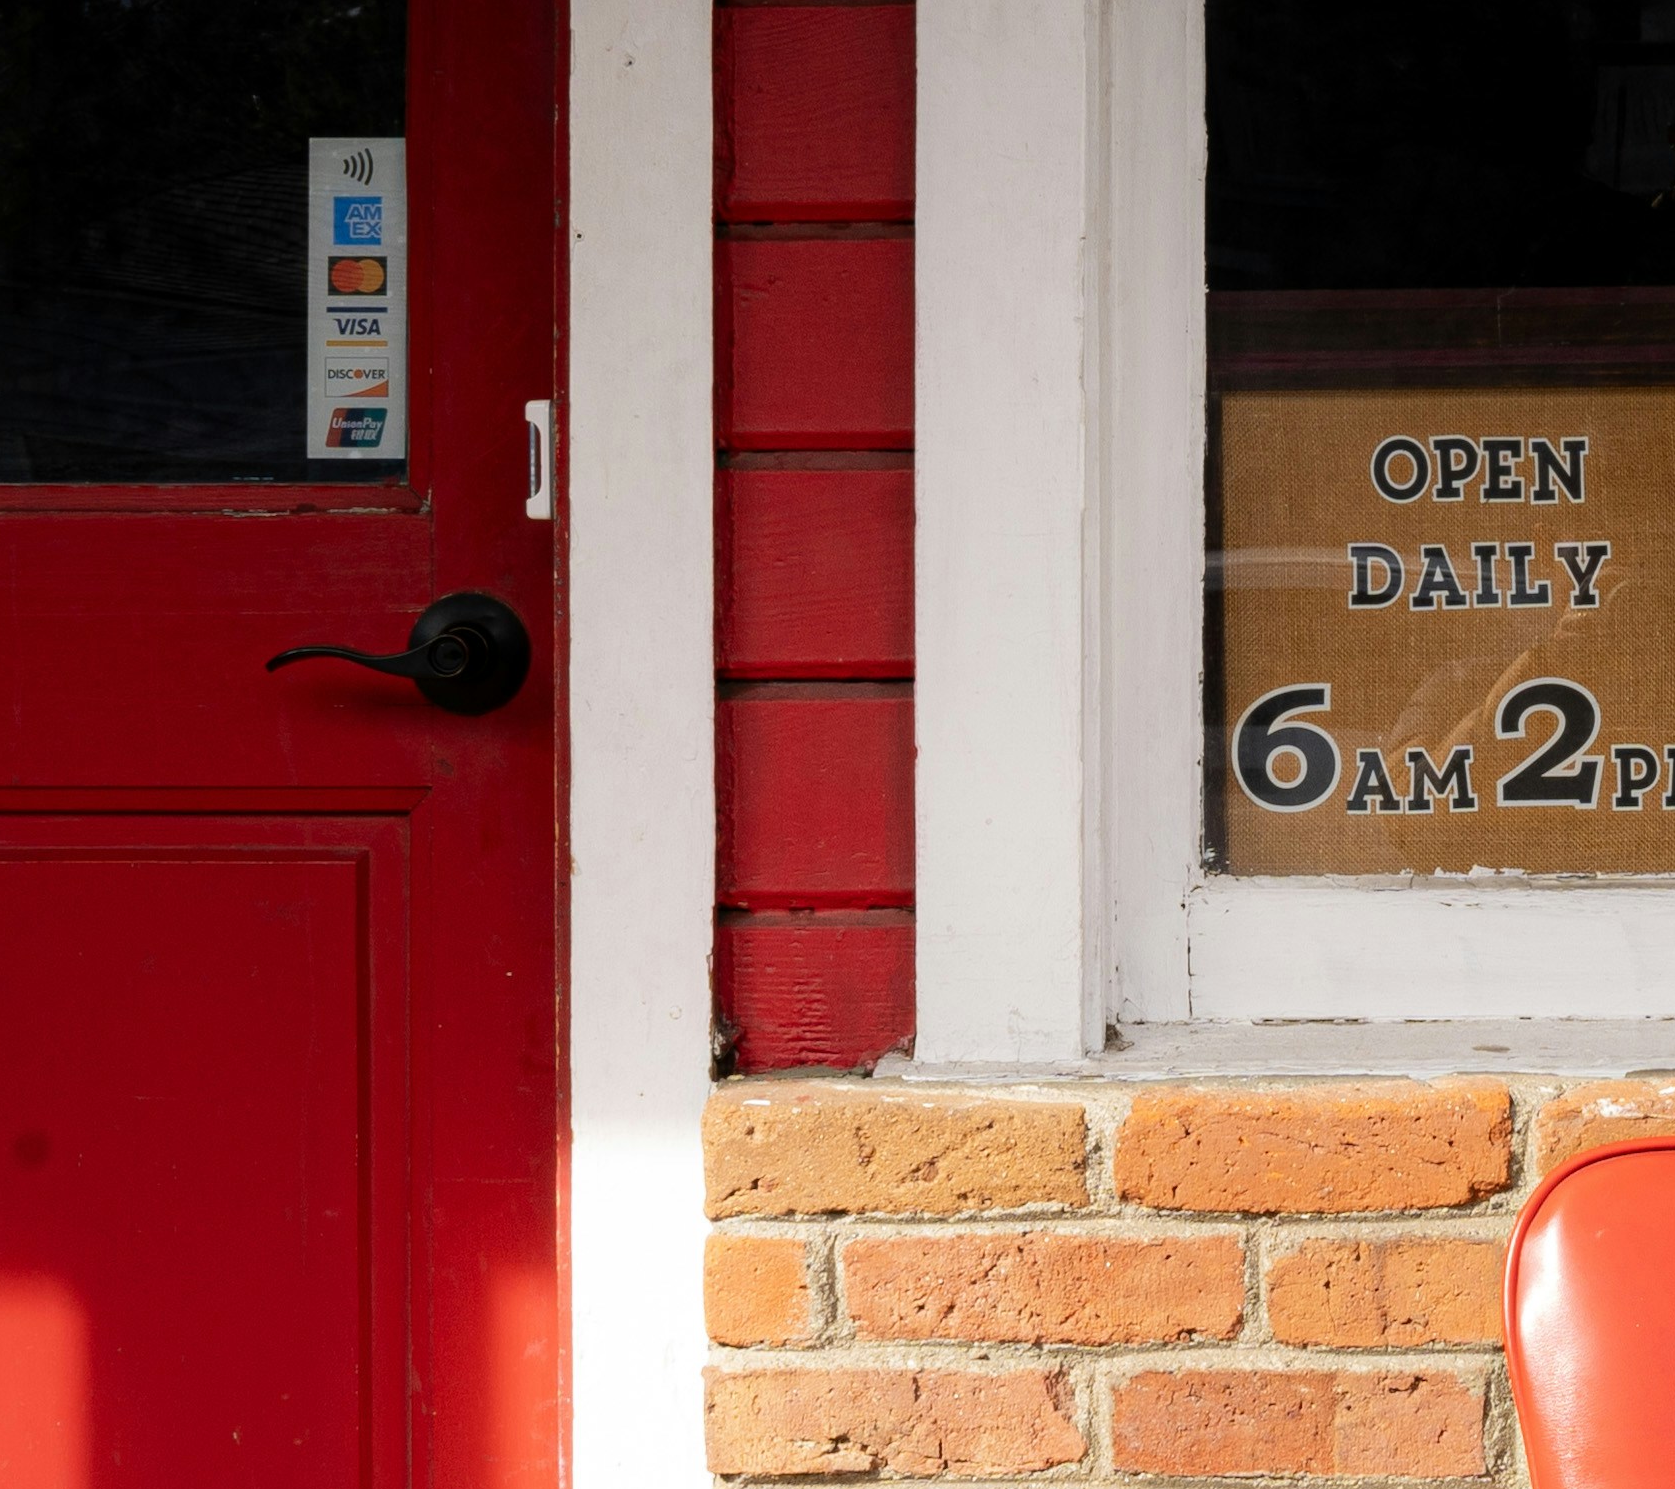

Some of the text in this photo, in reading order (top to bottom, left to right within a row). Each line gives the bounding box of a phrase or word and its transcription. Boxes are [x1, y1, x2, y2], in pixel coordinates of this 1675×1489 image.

[344, 203, 382, 222] AM
[333, 318, 381, 335] VISA
[327, 368, 386, 380] DISCOVER
[332, 417, 383, 433] UnionPay
[1370, 435, 1589, 504] OPEN
[1346, 540, 1611, 611] DAILY
